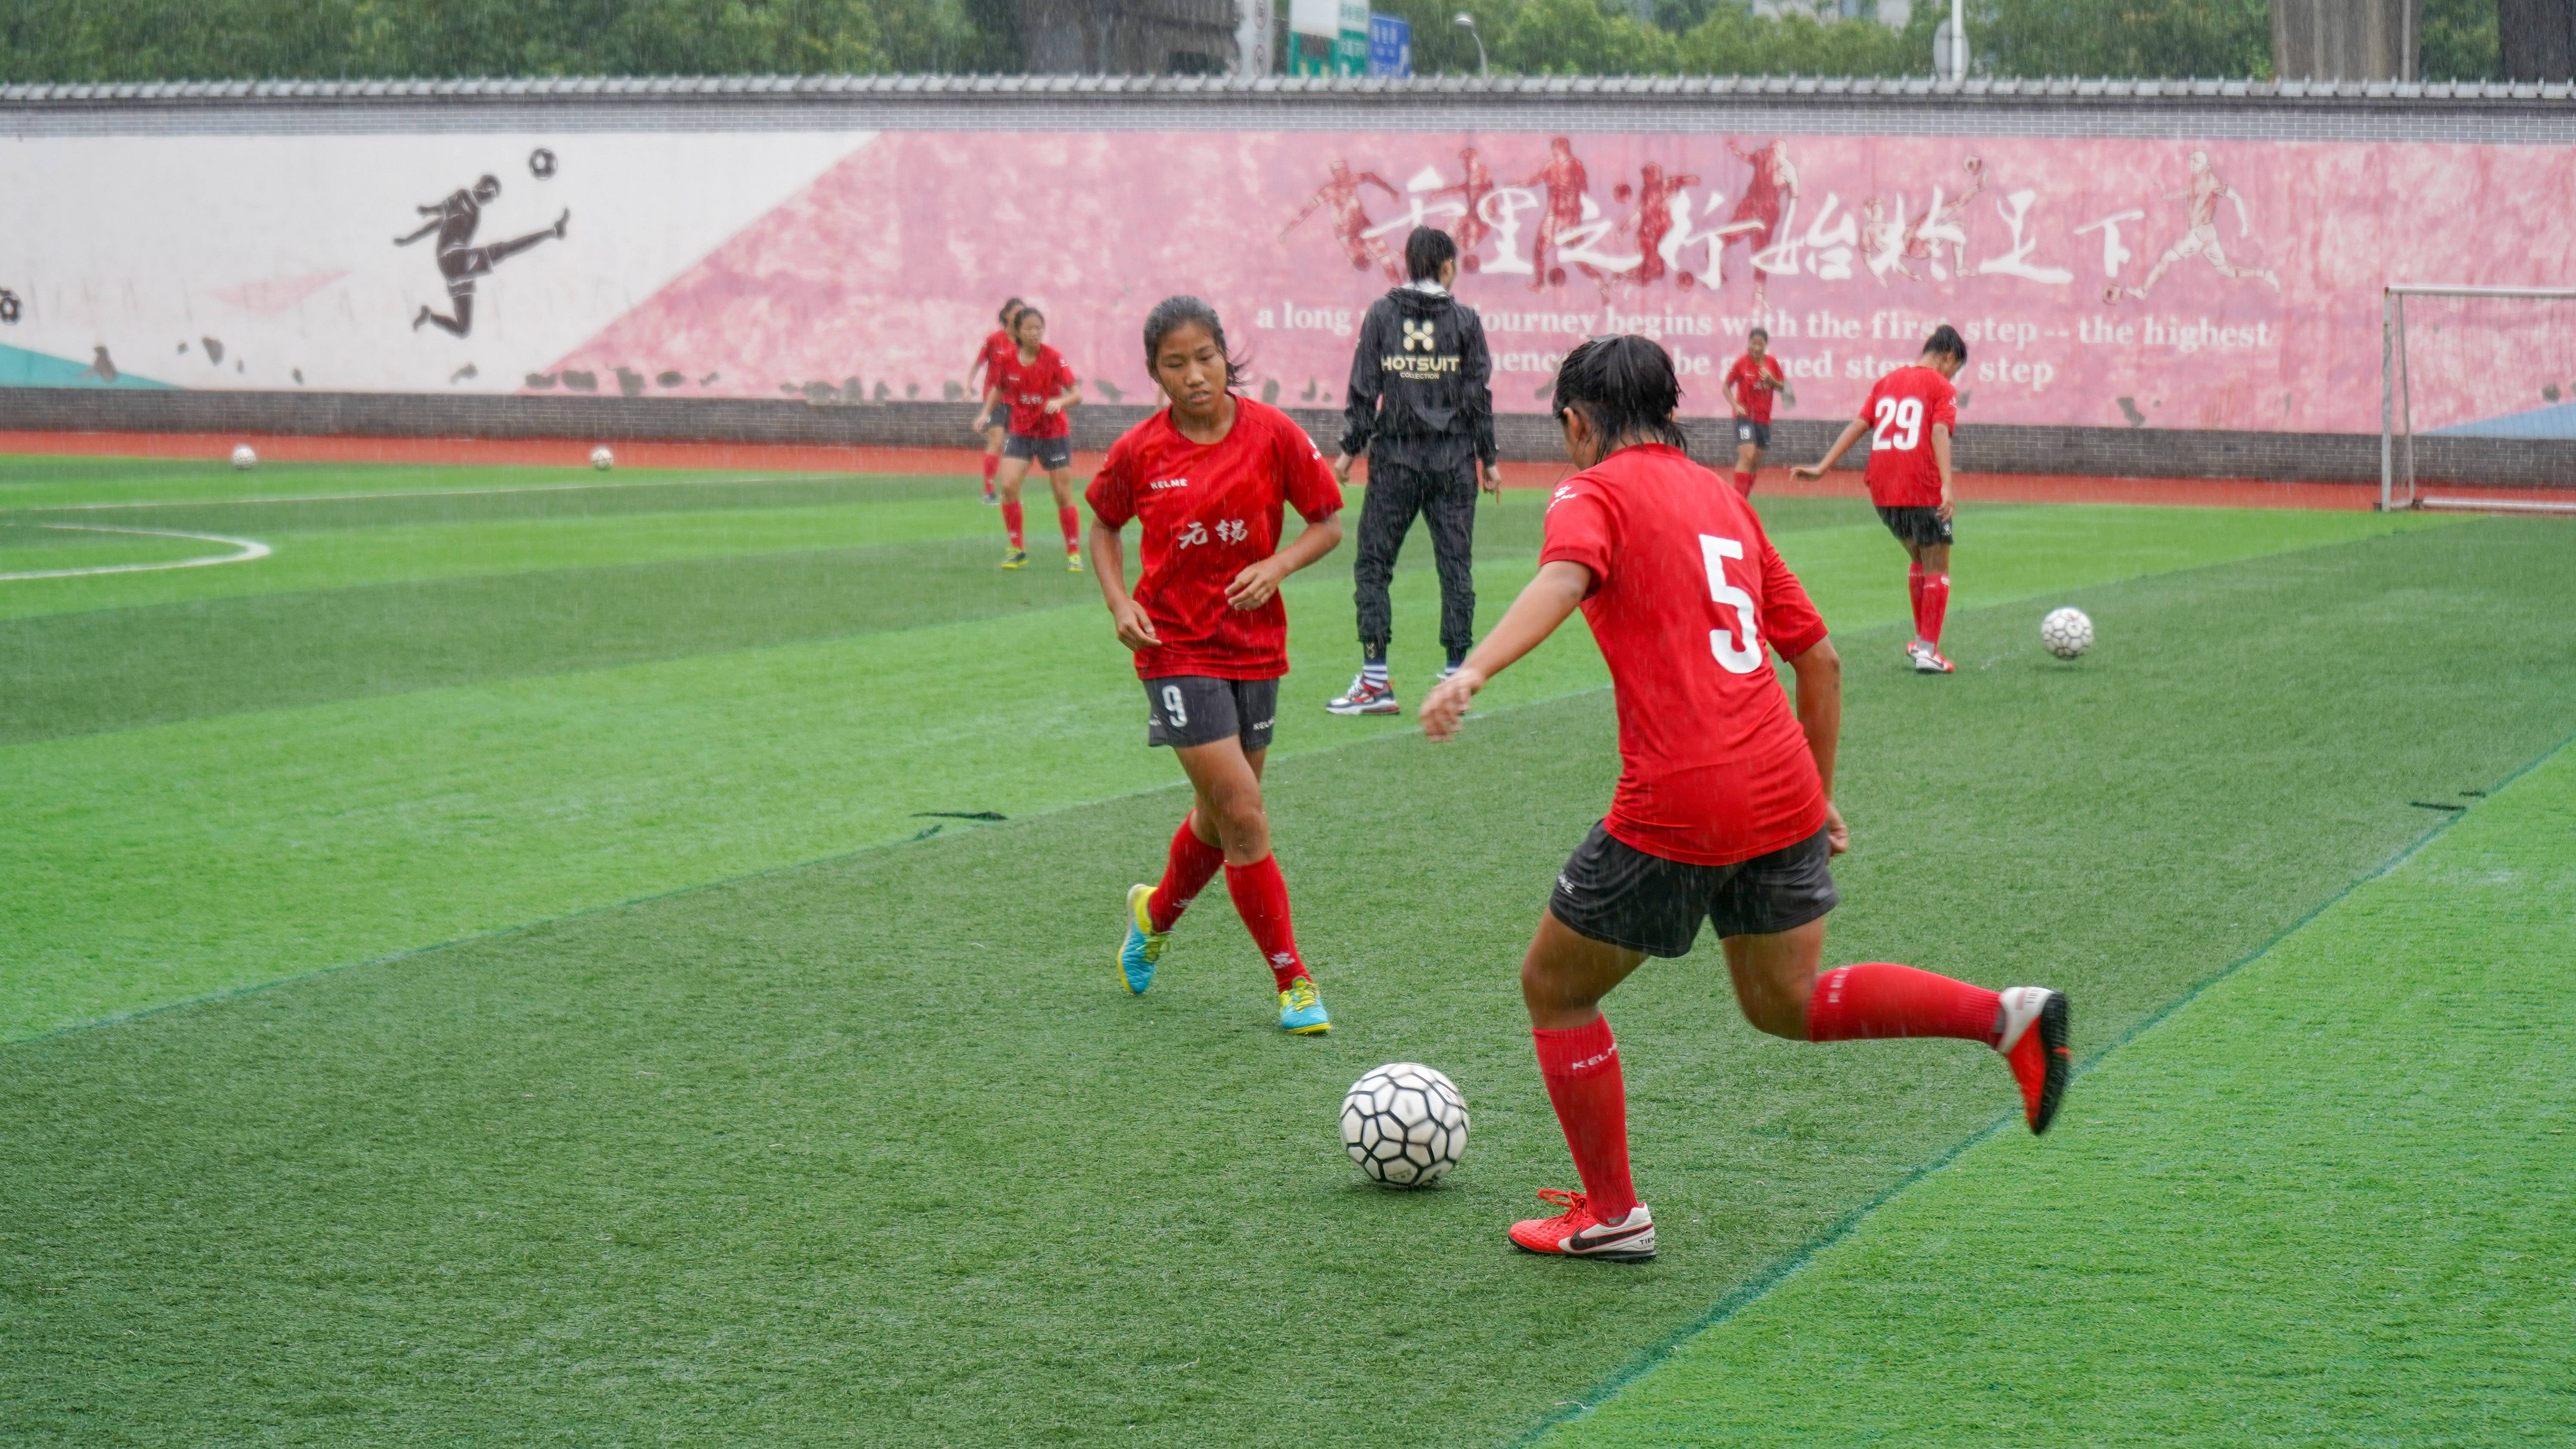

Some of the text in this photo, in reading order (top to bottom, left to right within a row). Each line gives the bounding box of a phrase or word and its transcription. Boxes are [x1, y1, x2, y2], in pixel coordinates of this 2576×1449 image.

[1257, 308, 1275, 329] a
[1283, 301, 1352, 336] long
[1473, 304, 1598, 340] ourney
[1606, 306, 1713, 340] begins
[1720, 310, 1798, 338] with
[1807, 310, 1861, 339] the
[1964, 317, 2037, 350] step
[2078, 315, 2134, 344] the
[2143, 315, 2269, 354] highest
[1380, 357, 1460, 372] HOTSUIT
[1674, 348, 1710, 376] be
[1978, 357, 2054, 391] step
[1872, 397, 1923, 451] 29
[1150, 479, 1188, 490] KELME
[1698, 534, 1762, 674] 5
[1162, 685, 1188, 728] 9
